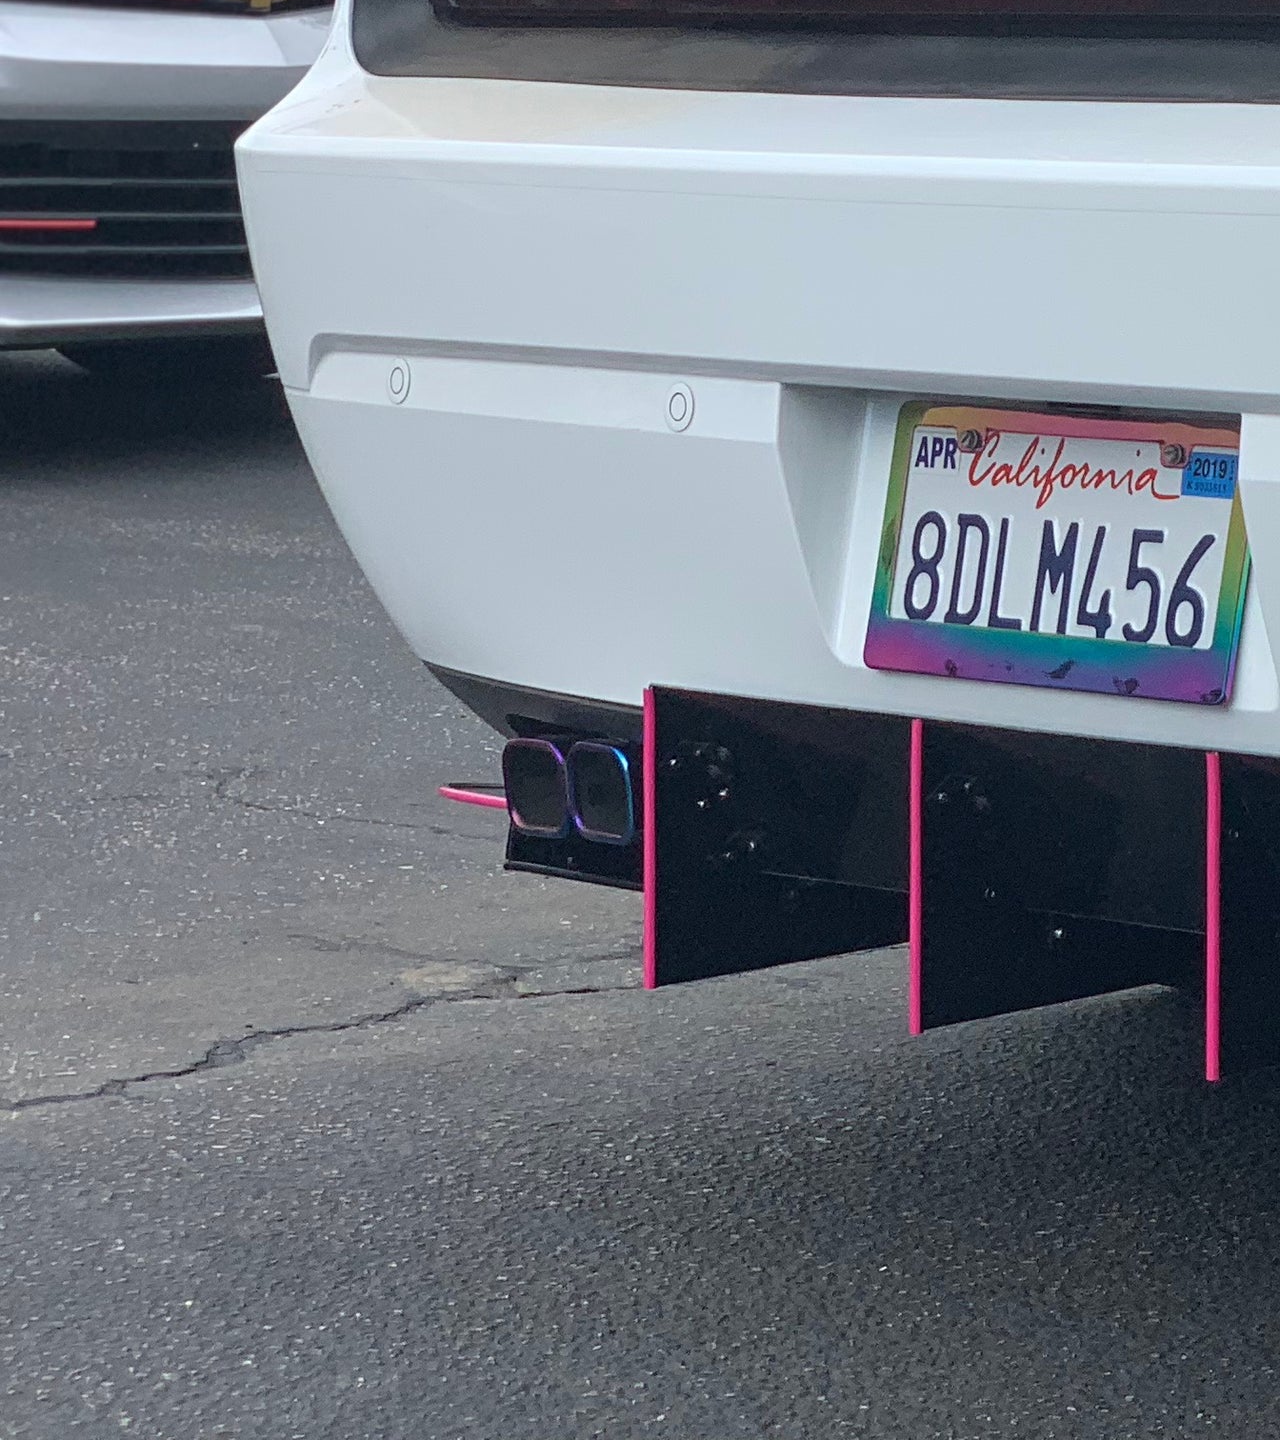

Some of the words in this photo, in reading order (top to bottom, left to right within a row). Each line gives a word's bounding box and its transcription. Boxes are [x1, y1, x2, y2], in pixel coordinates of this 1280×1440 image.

[914, 435, 959, 470] APR
[967, 430, 1181, 509] California
[1193, 458, 1228, 479] 2019
[903, 510, 1216, 648] 8DLM456
